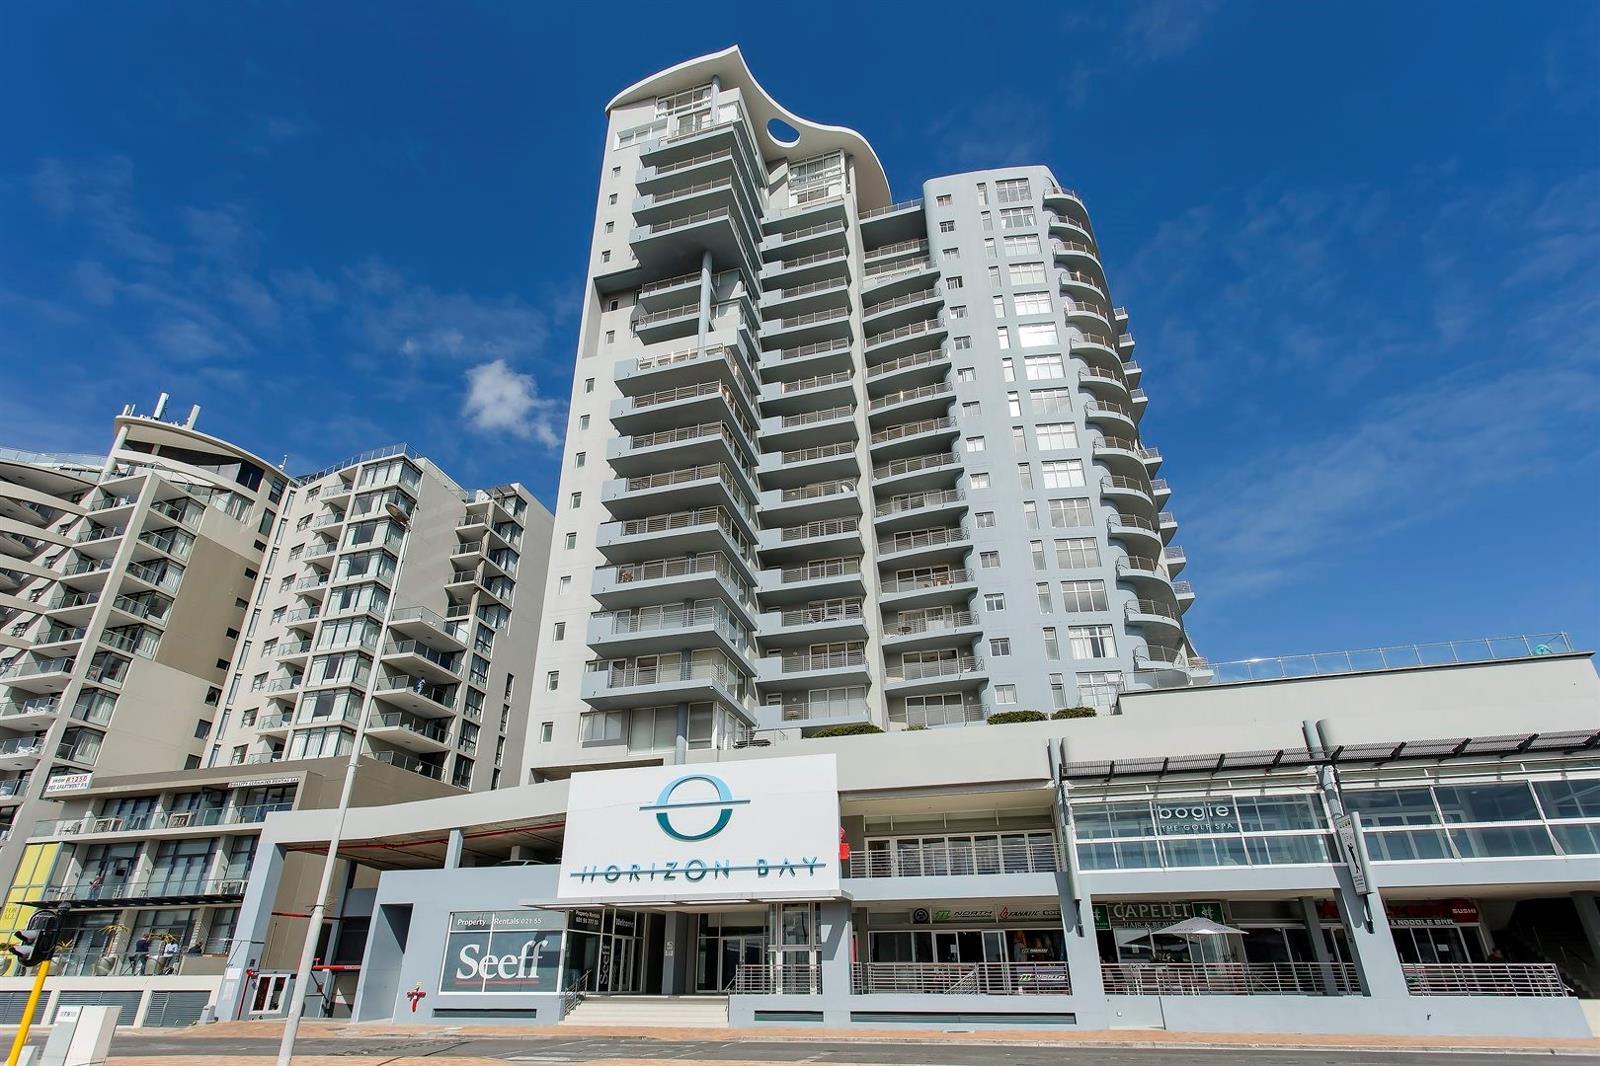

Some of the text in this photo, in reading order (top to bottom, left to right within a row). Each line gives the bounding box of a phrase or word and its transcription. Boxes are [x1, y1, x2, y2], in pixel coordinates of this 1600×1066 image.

[1157, 802, 1229, 821] bogie
[1214, 822, 1234, 830] SPA
[578, 855, 820, 884] HORIZON BAY
[1007, 910, 1040, 918] FANATIC
[456, 918, 487, 927] Property
[494, 917, 520, 925] Rentals
[1434, 918, 1455, 926] BAR
[456, 939, 549, 979] Seeff
[599, 943, 611, 985] Seeff
